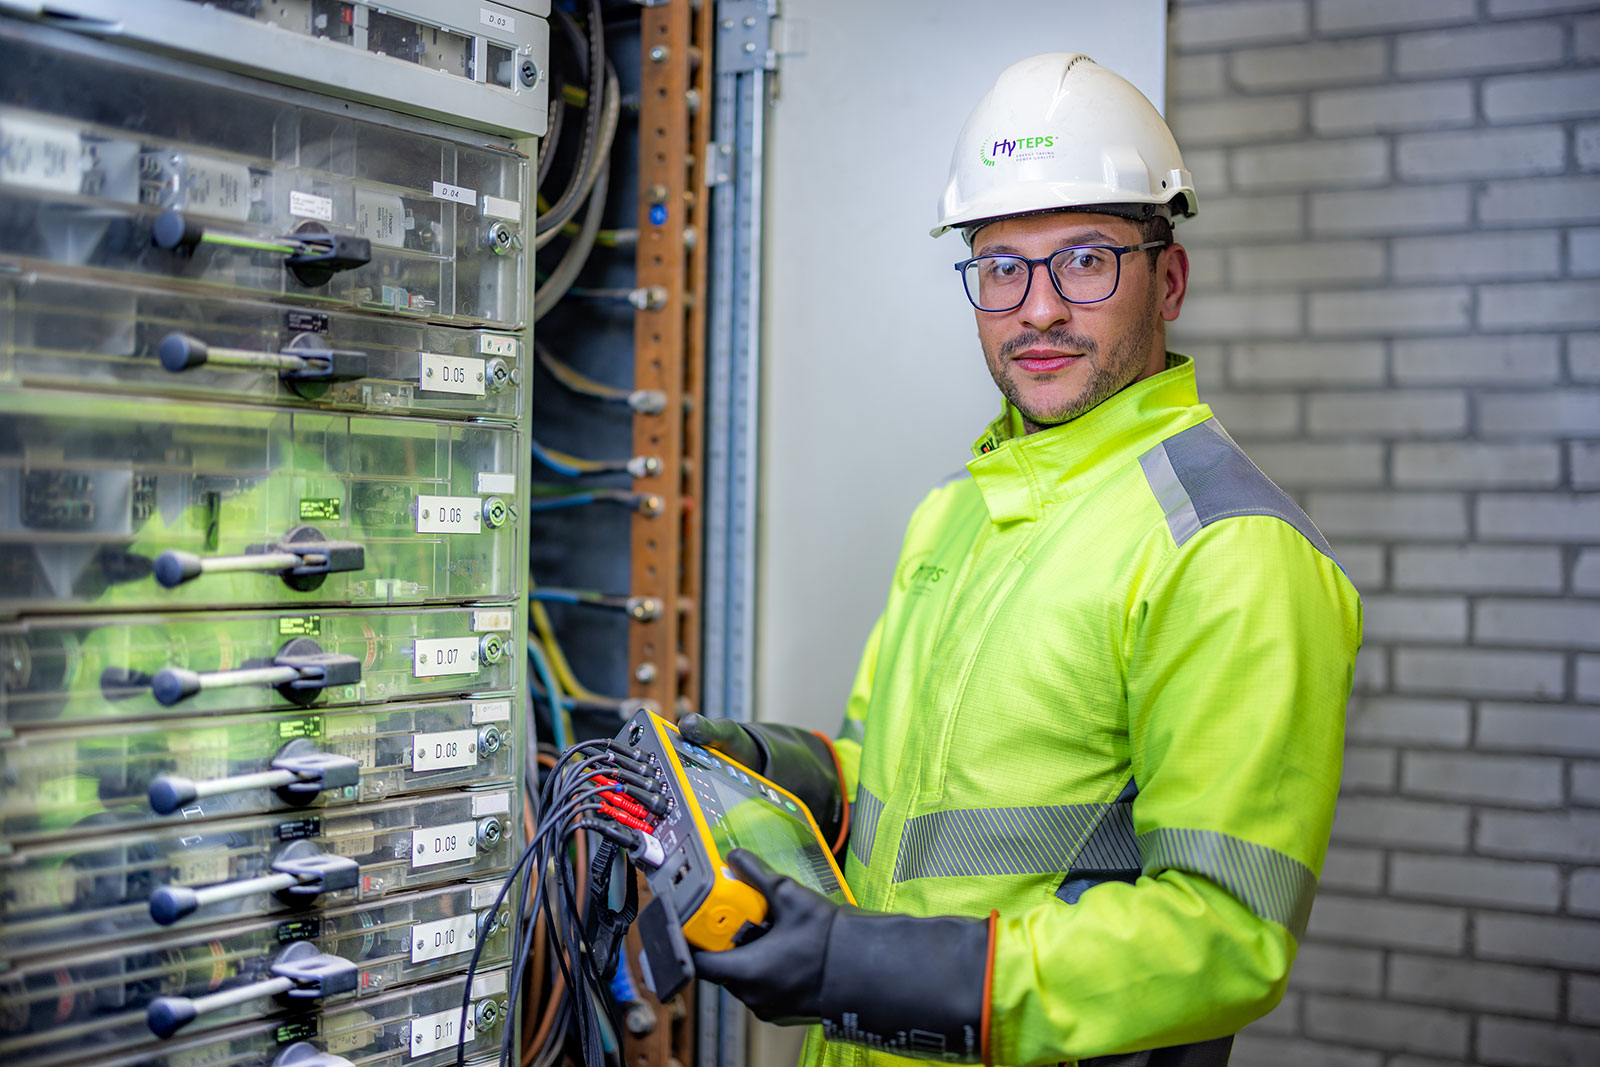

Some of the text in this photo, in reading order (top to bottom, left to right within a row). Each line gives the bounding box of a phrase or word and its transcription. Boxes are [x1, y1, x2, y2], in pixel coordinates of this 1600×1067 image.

[488, 15, 506, 27] D.03
[992, 135, 1054, 157] HyTEPS
[442, 187, 460, 198] D.04
[443, 366, 465, 383] D.05
[439, 507, 461, 523] D.06
[437, 648, 458, 665] D.07
[435, 742, 458, 759] D.08
[435, 835, 456, 853] D.09
[435, 929, 455, 947] D.10
[435, 1021, 453, 1040] D.11
